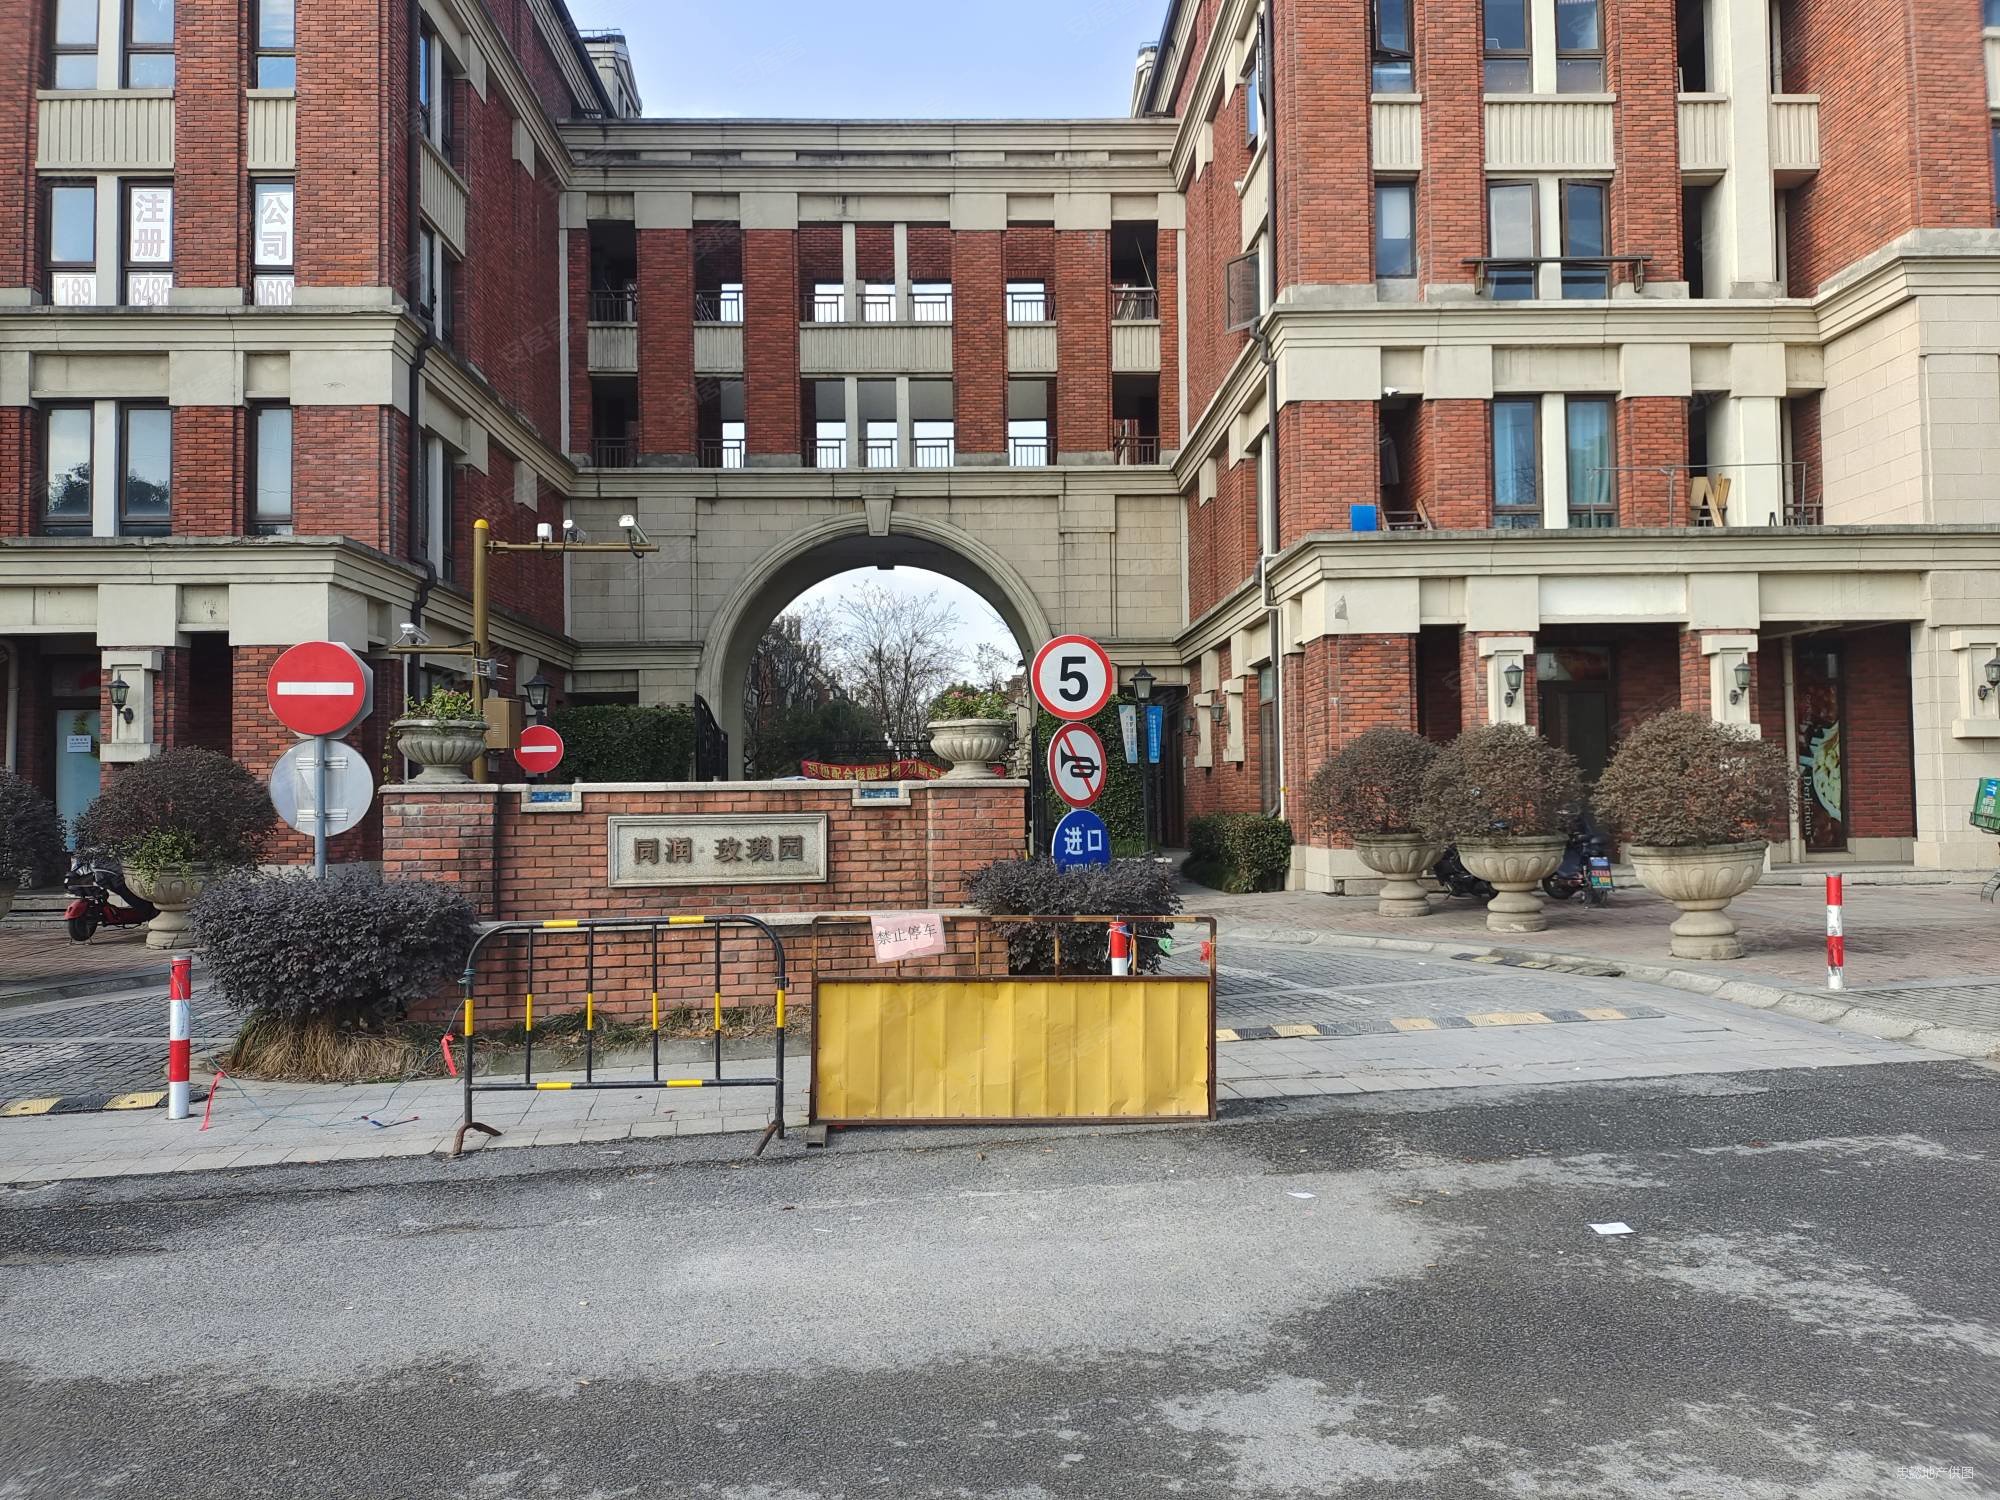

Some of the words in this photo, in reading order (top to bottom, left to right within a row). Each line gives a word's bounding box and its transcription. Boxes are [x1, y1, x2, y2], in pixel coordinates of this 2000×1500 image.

[135, 193, 165, 257] 注册
[261, 197, 289, 260] 公司
[61, 278, 92, 305] 189
[1059, 656, 1089, 701] 5
[1064, 826, 1102, 855] 进口
[877, 923, 937, 945] 禁止停车
